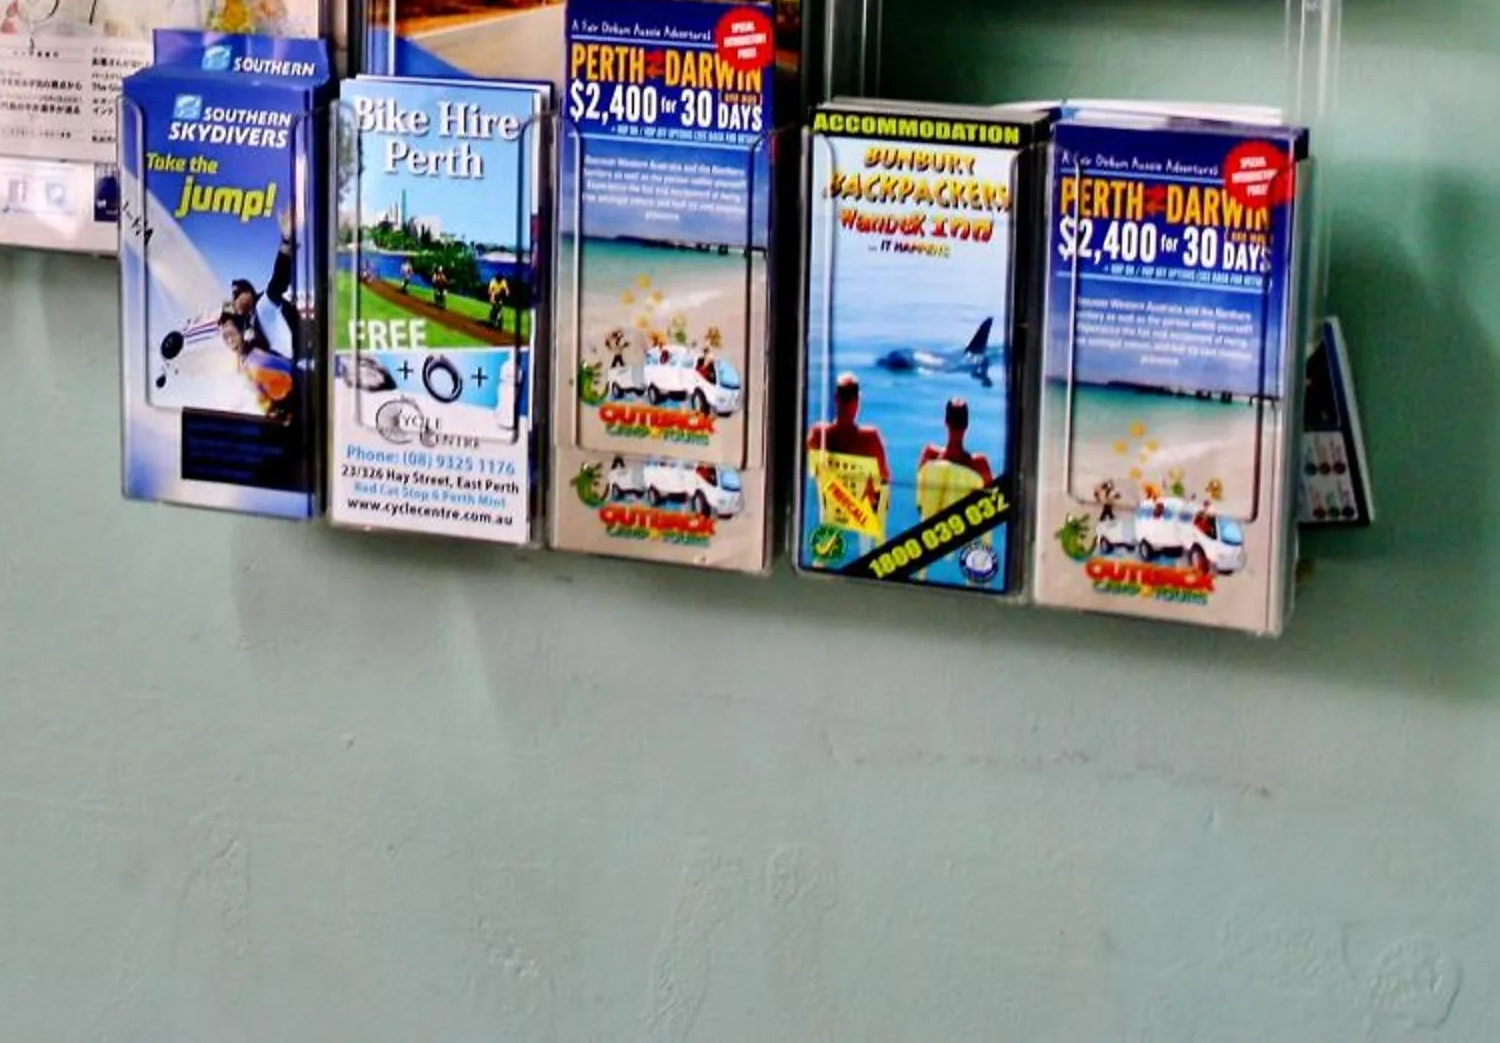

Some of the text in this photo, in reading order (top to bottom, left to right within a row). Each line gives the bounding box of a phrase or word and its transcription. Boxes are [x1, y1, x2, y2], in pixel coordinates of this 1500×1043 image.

[233, 57, 315, 77] SOUTHERN
[571, 43, 762, 92] PERTH DARWIN
[203, 107, 291, 127] SOUTHERN
[353, 96, 522, 141] Bike Hire
[570, 78, 763, 131] $2,400 for 30 DAYS
[168, 122, 289, 148] SKYDIVERS
[813, 112, 1020, 145] ACCOMMODATION
[147, 153, 219, 174] Take the
[385, 139, 484, 180] Perth
[863, 146, 977, 175] BUNBURY
[175, 175, 277, 223] jump!
[825, 169, 1013, 214] BACKPACKERS
[1060, 177, 1143, 222] PERTH
[931, 216, 995, 245] Inn
[1059, 218, 1271, 273] $2,400 for 30 DAYS
[348, 318, 427, 350] FREE
[386, 470, 520, 494] Hay Street, East Perth
[869, 538, 923, 579] 1800
